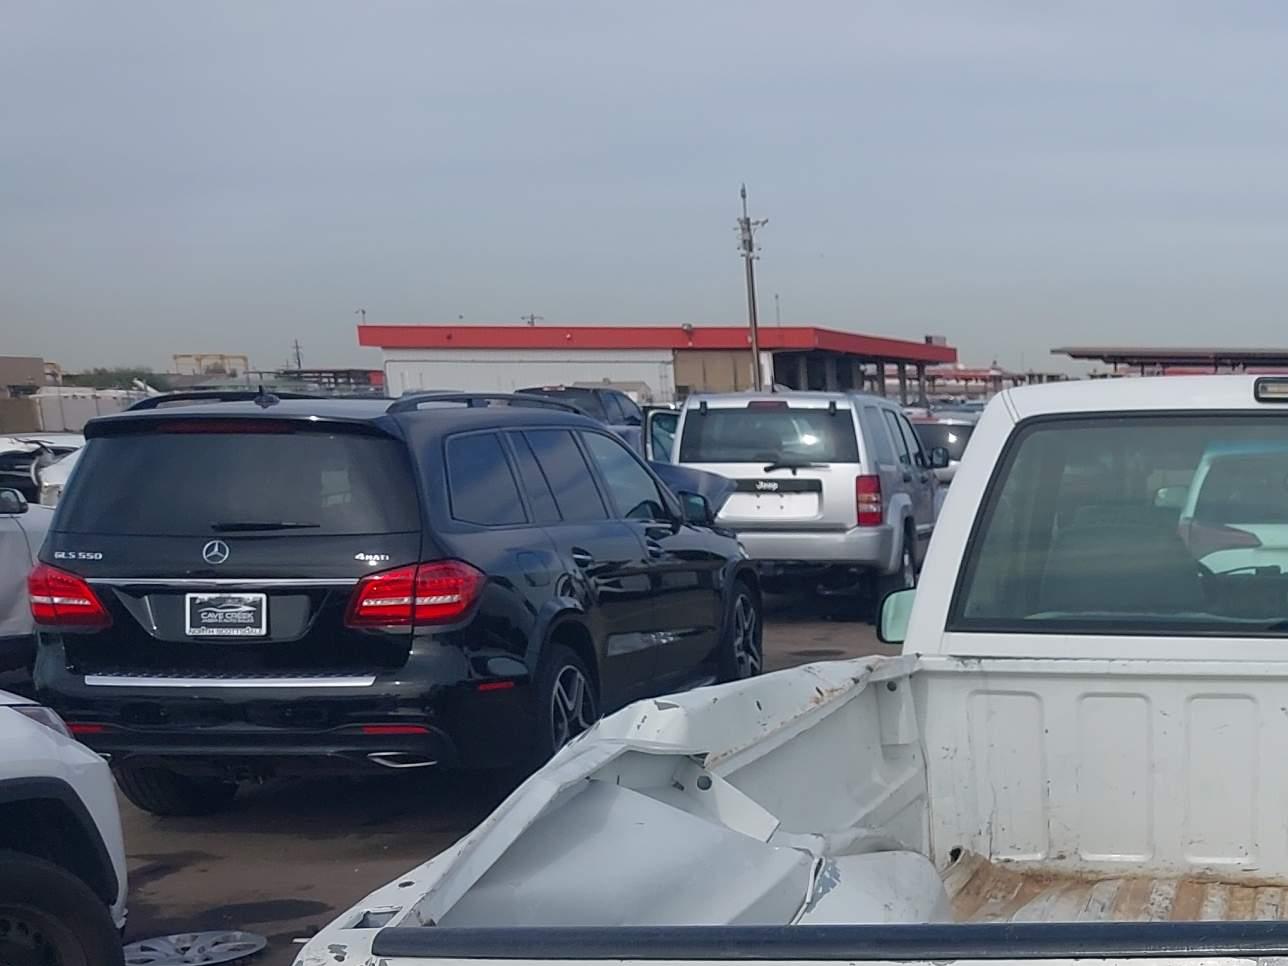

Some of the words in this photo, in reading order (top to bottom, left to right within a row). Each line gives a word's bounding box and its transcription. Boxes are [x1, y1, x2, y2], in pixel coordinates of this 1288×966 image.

[755, 481, 778, 490] Jeep
[78, 552, 103, 560] 550
[201, 612, 224, 620] CAVE
[225, 612, 254, 620] CREEK
